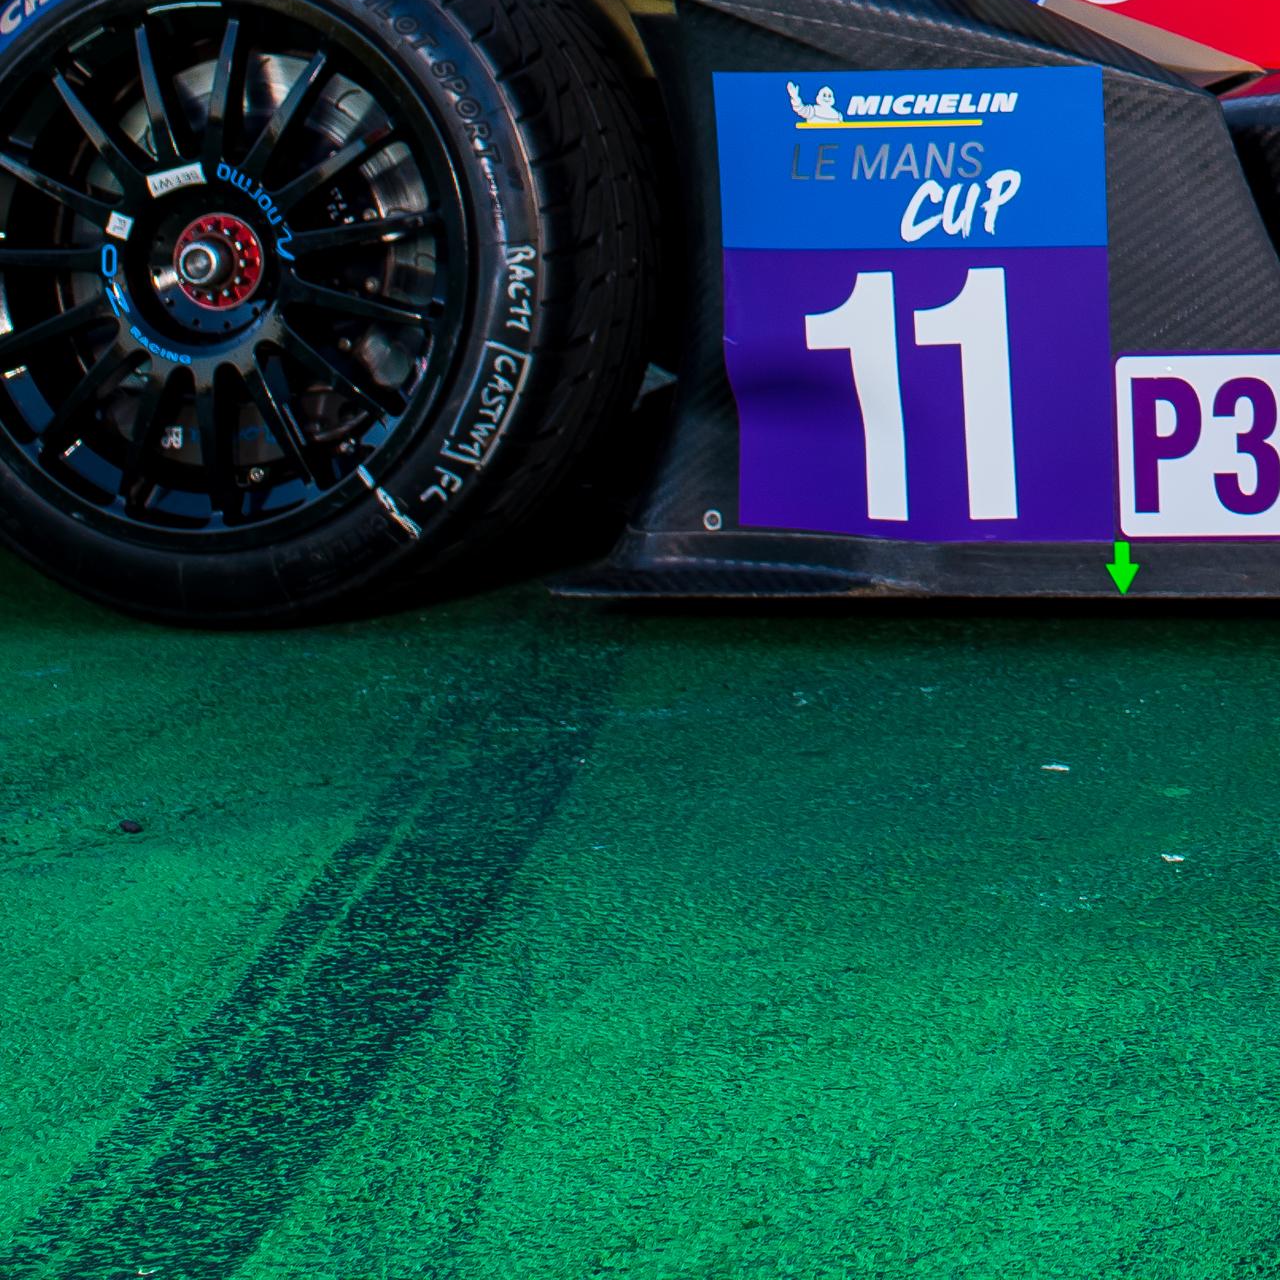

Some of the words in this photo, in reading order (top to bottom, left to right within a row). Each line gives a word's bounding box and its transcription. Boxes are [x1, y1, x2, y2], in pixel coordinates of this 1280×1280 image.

[847, 92, 1018, 116] MICHELIN
[791, 143, 839, 181] LE
[852, 141, 985, 181] MANS
[901, 169, 1022, 243] CUP
[129, 325, 192, 365] RACING
[804, 267, 1018, 521] 11
